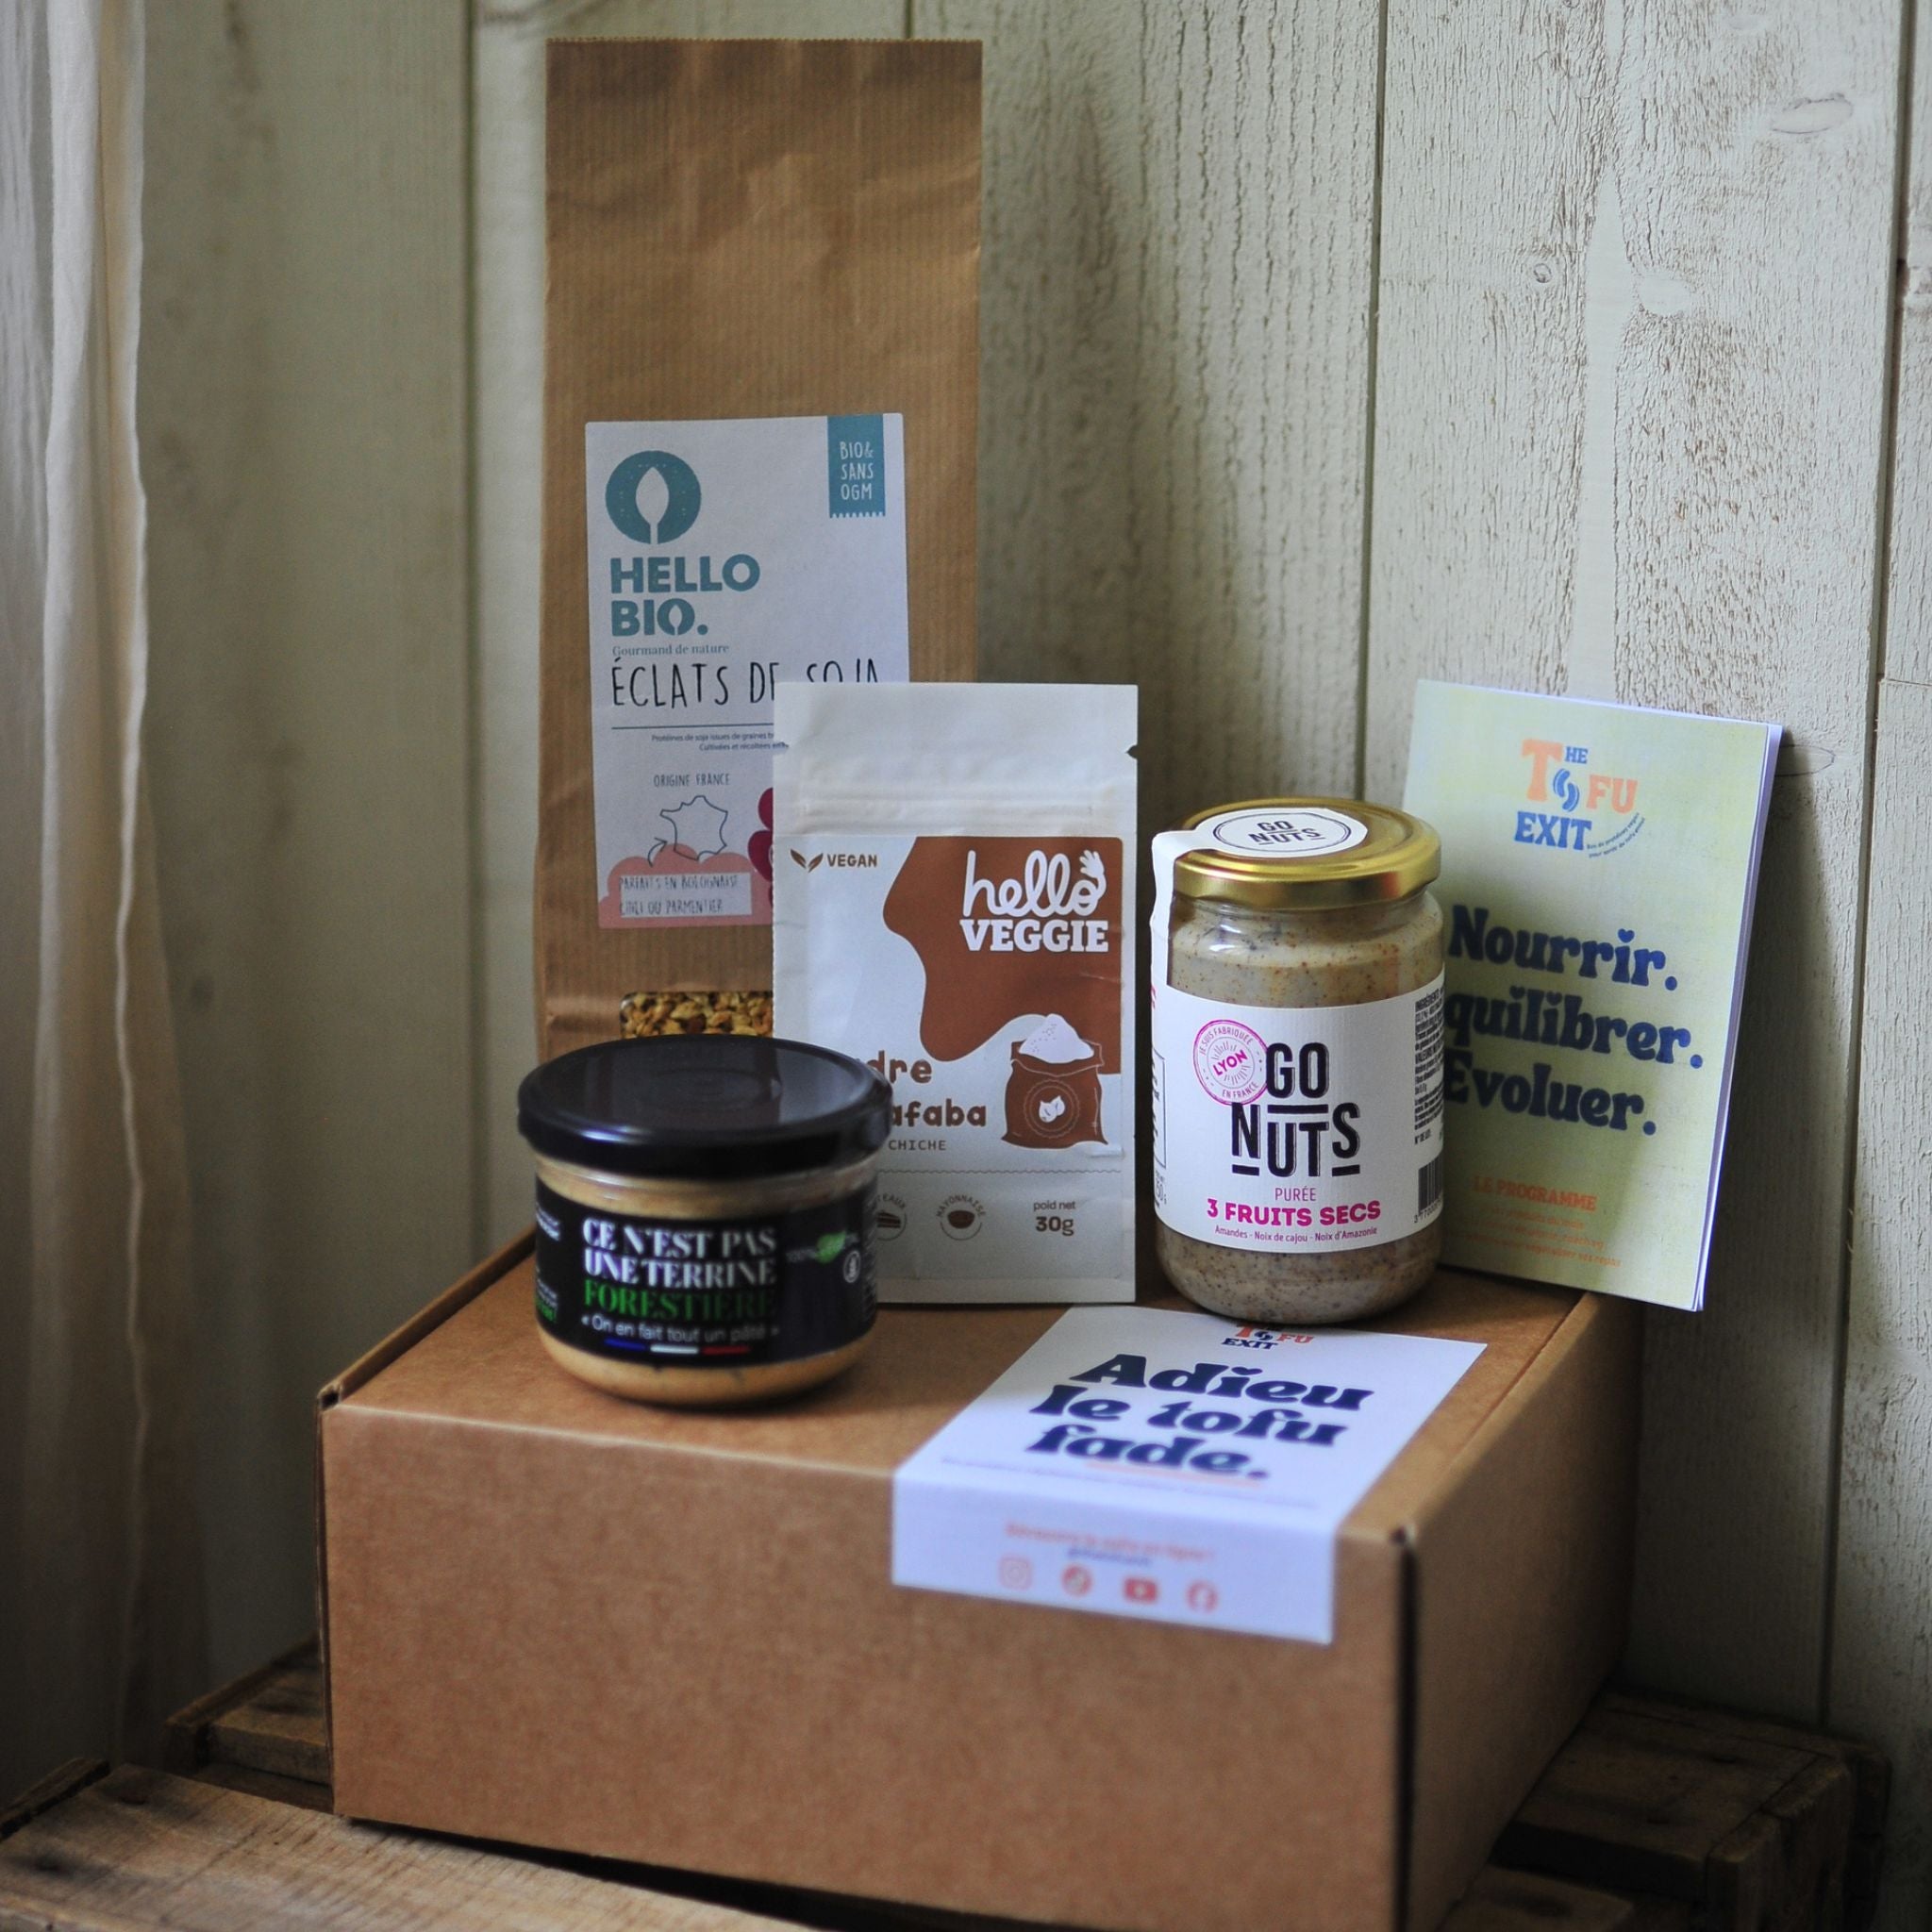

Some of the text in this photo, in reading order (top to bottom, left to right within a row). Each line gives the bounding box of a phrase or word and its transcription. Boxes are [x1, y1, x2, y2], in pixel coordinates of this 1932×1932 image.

[841, 462, 874, 480] SANS
[841, 483, 873, 500] OGM
[610, 554, 760, 593] HELLO
[611, 598, 708, 637] BIO.
[612, 643, 729, 656] Gourmand de nature
[612, 657, 729, 708] ÉCLATS
[654, 773, 730, 788] ORIGINE FRANCE
[1248, 827, 1325, 845] NUTS
[1257, 820, 1294, 831] GO
[1514, 810, 1593, 851] EXIT
[827, 853, 878, 868] VEGAN
[962, 849, 1107, 919] hello
[959, 919, 1109, 953] VEGGIE
[1448, 904, 1678, 991] Nourrir.
[1444, 985, 1704, 1069] quilibrer.
[1212, 1049, 1248, 1076] LYON
[1265, 1041, 1330, 1099] GO
[1222, 1080, 1259, 1099] EN FRANCE
[889, 1140, 946, 1151] CHICHE
[1231, 1102, 1361, 1177] NUTS
[936, 1193, 987, 1218] MAYONNAISE
[1033, 1200, 1076, 1212] poid net
[1274, 1187, 1317, 1202] PURÉE
[1473, 1176, 1598, 1212] LE PROGRAMME
[1208, 1198, 1381, 1226] 3 FRUITS SECS
[583, 1217, 616, 1251] CE
[624, 1225, 713, 1258] N'EST
[722, 1228, 776, 1257] PAS
[1035, 1216, 1074, 1237] 30g
[1215, 1224, 1377, 1245] Amandes Noix de cajou Noix d'Amazonie
[584, 1247, 776, 1289] UNE TERRINE
[615, 1323, 636, 1337] en
[638, 1324, 664, 1340] fait
[666, 1325, 700, 1342] tout
[704, 1328, 726, 1341] un
[1221, 1338, 1278, 1349] EXIT
[1069, 1353, 1374, 1410] Adieu
[1028, 1384, 1348, 1446] le tofu
[1024, 1424, 1271, 1478] fade.
